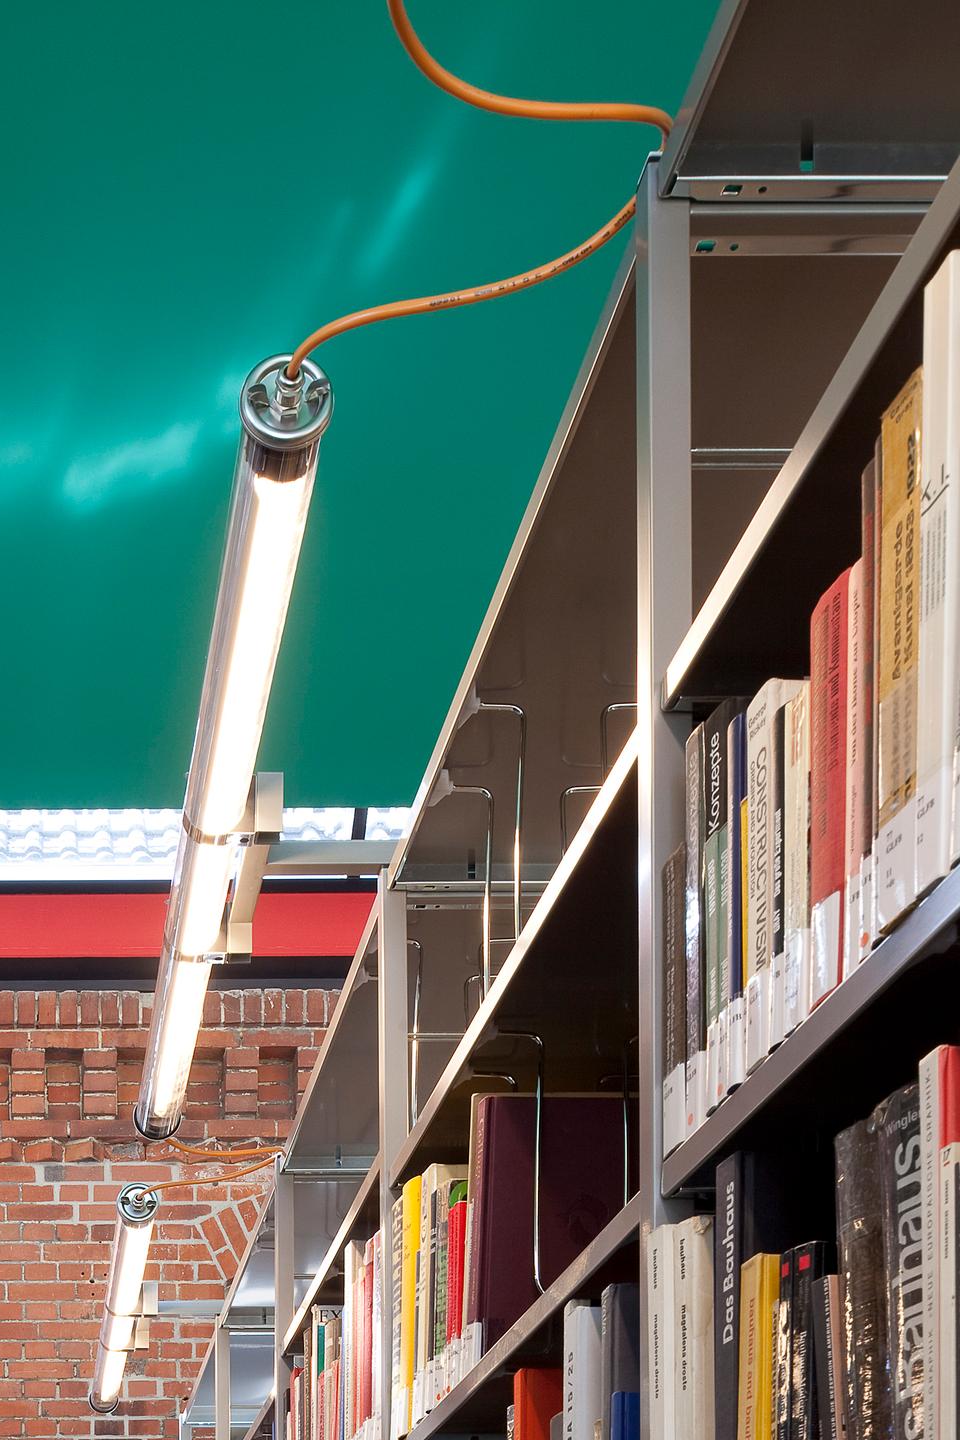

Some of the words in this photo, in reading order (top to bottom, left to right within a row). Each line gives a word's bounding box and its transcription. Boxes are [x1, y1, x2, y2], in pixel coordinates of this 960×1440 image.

[893, 520, 903, 680] Avantgarde
[708, 731, 722, 835] Konzepte
[755, 746, 767, 971] CONSTRUCTIVISM
[722, 1181, 734, 1293] Bauhaus
[893, 1134, 923, 1403] Bauhaus
[319, 1309, 343, 1323] EX
[680, 1304, 688, 1359] magdalena
[723, 1295, 734, 1345] Das
[747, 1298, 756, 1367] bauhaus
[746, 1371, 754, 1402] and
